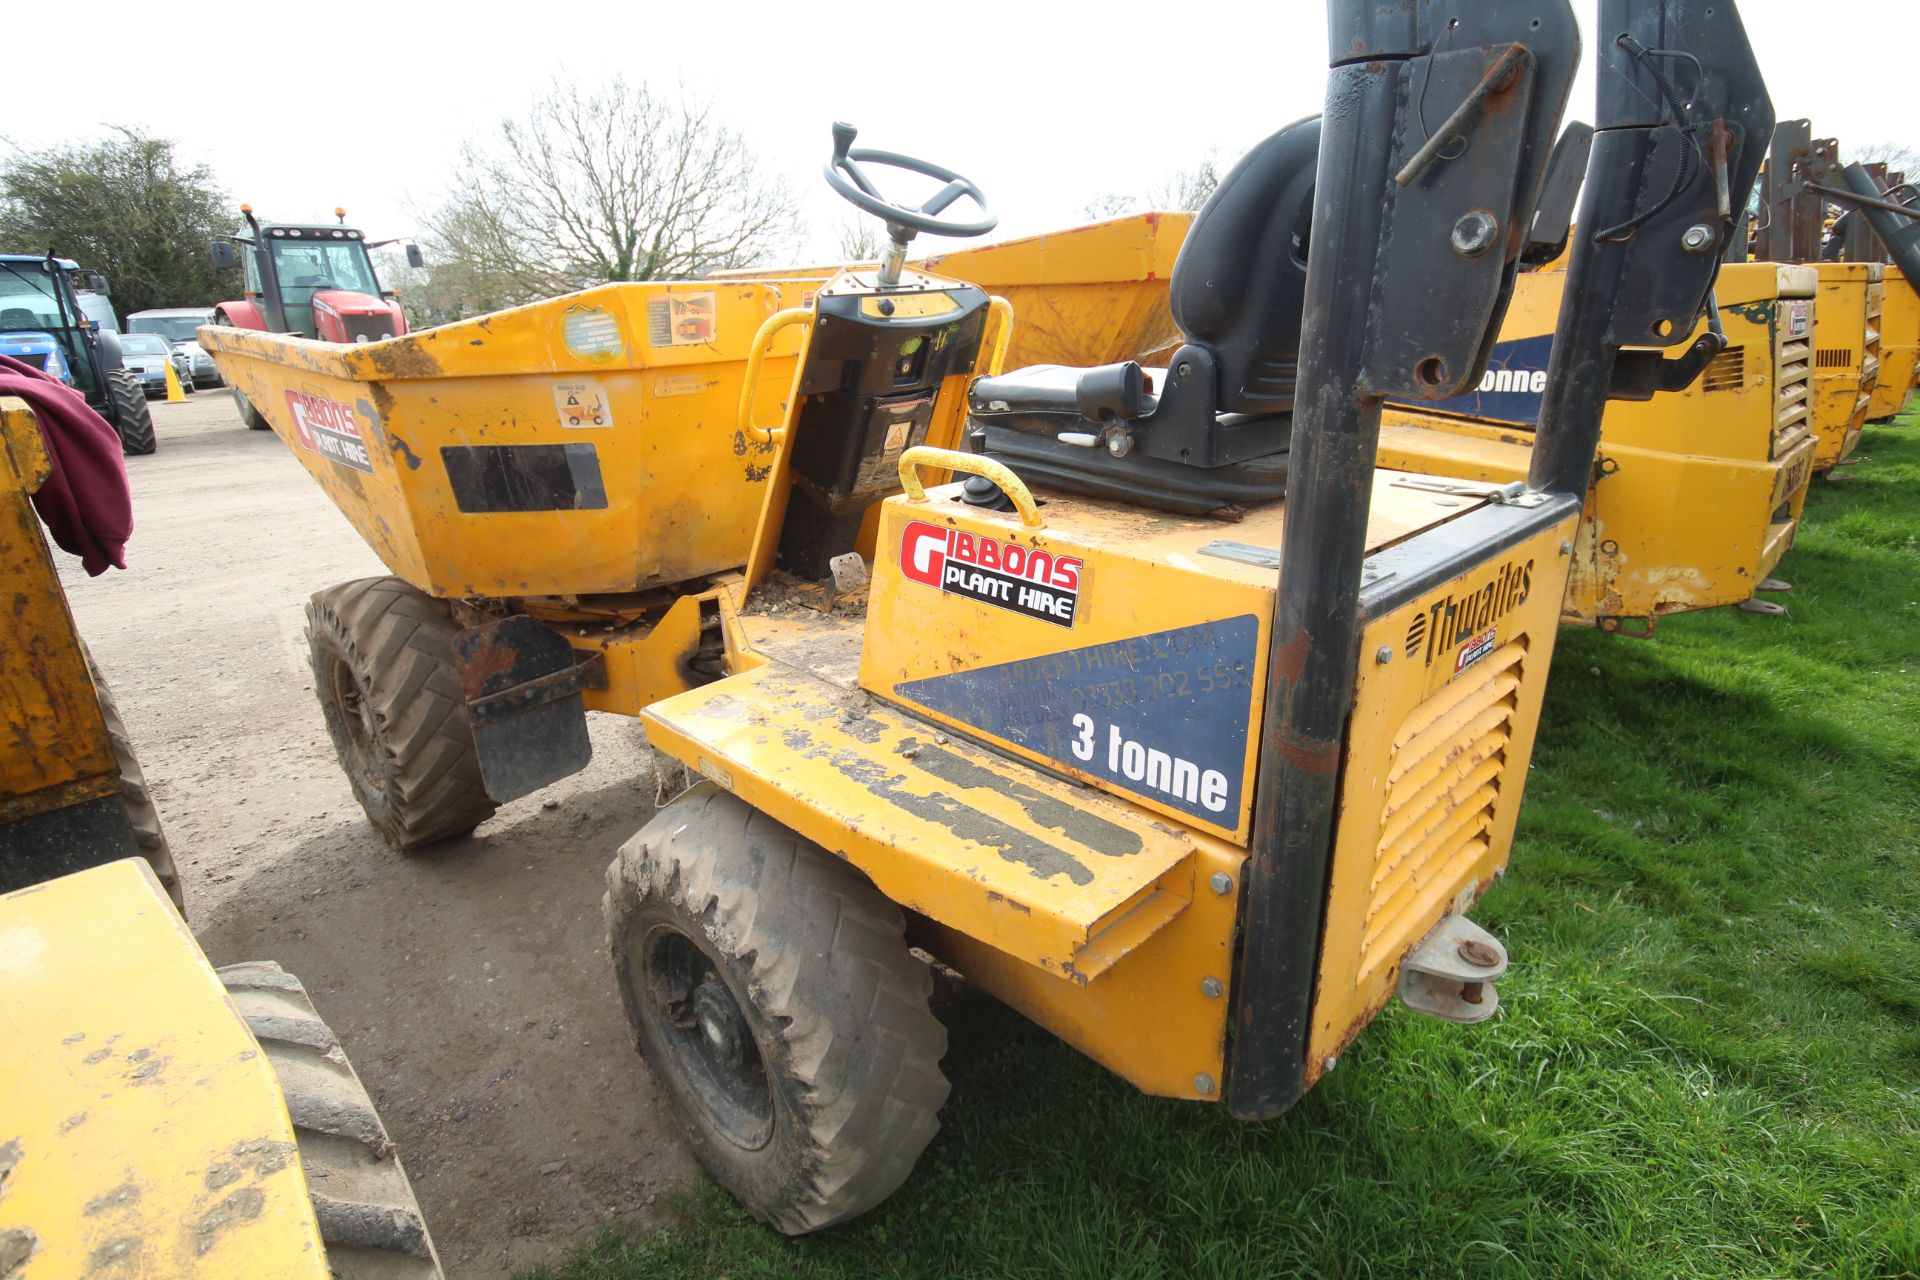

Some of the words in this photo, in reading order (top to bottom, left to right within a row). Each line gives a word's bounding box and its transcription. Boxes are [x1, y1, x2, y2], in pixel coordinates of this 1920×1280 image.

[1474, 370, 1547, 393] onne
[284, 388, 361, 454] GIBBONS
[340, 439, 370, 466] HIRE
[901, 520, 1083, 588] GIBBONS
[945, 565, 1014, 602] PLANT
[1018, 585, 1073, 620] HIRE
[1425, 559, 1535, 668] Thwaites
[1143, 669, 1193, 701] 202
[1071, 712, 1096, 762] 3
[1108, 724, 1229, 813] tonne
